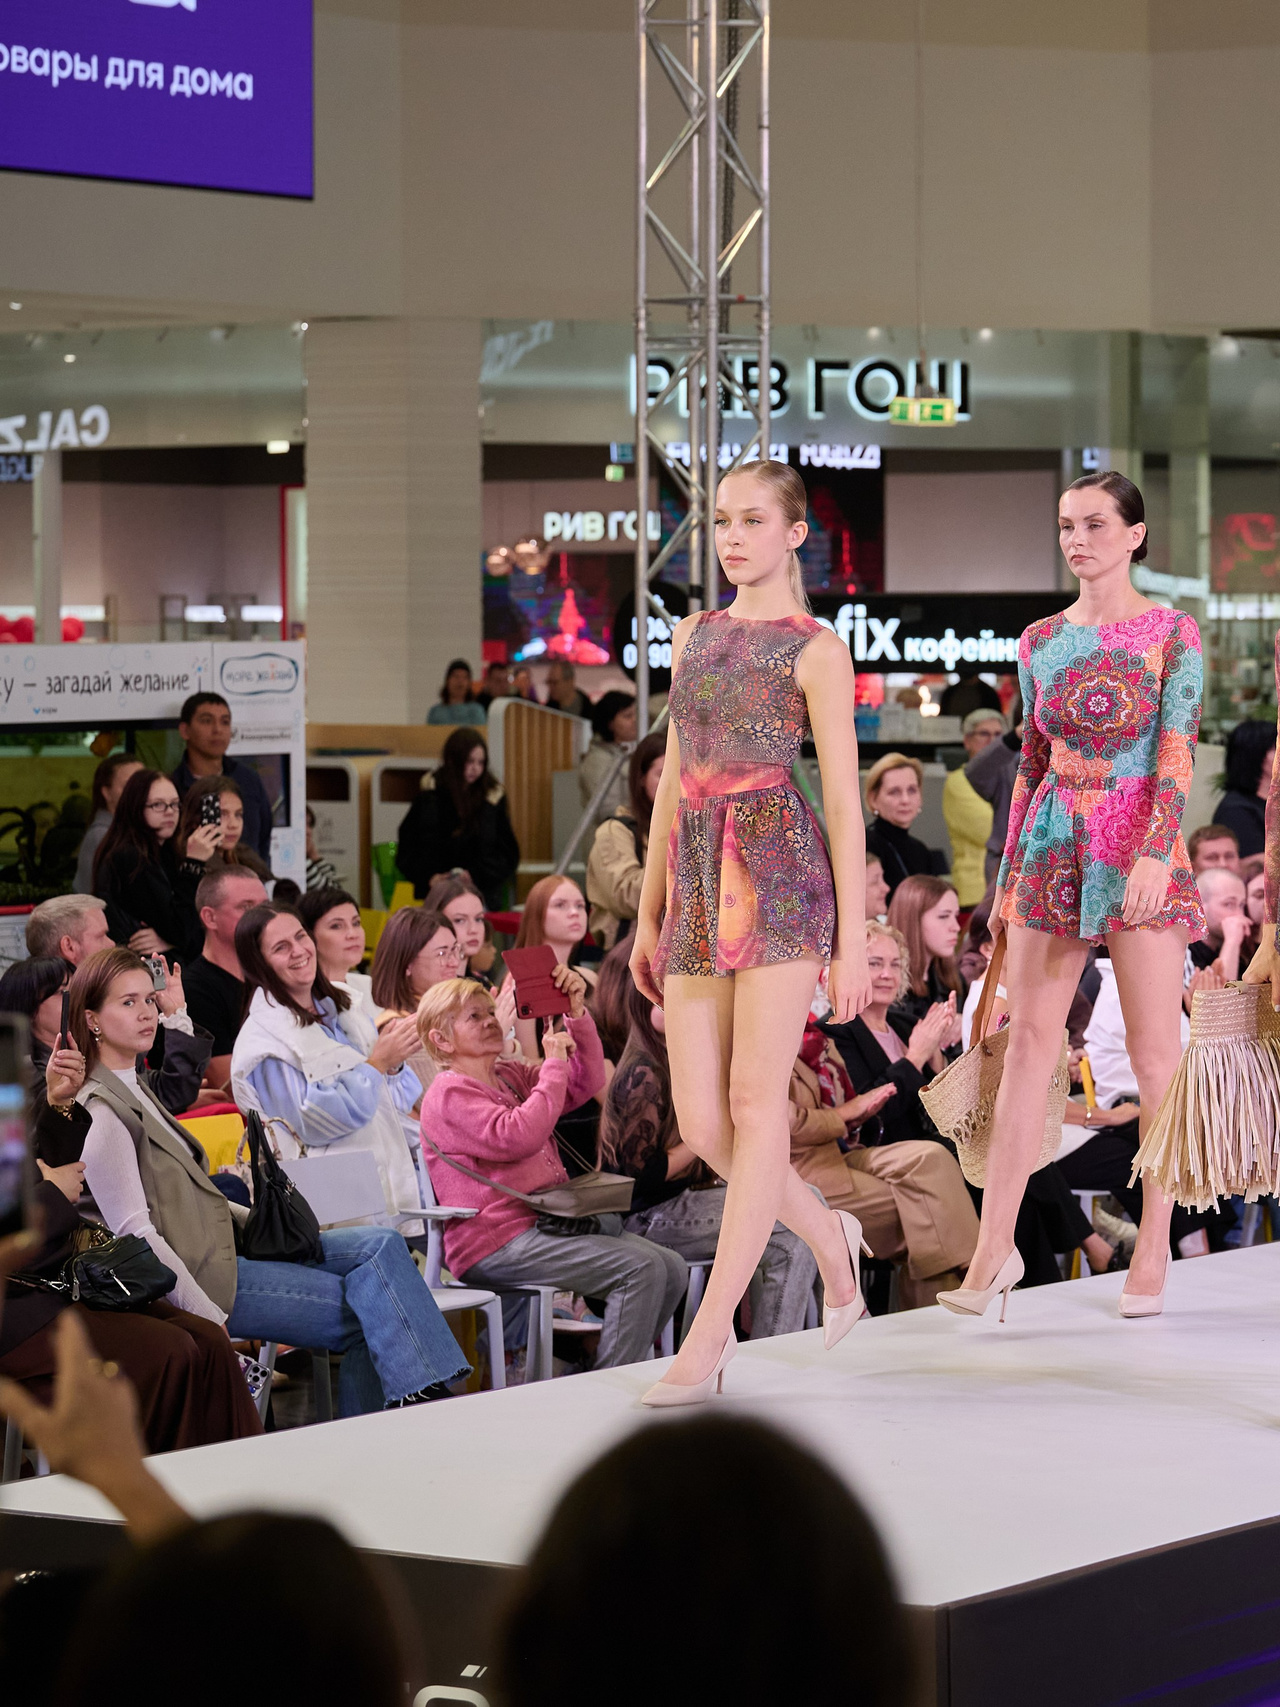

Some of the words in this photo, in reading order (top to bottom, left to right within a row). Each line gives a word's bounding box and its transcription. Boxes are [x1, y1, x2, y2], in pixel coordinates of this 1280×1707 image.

[104, 57, 164, 90] для
[170, 65, 254, 101] дома
[807, 357, 971, 422] ГОШ
[543, 511, 605, 541] РИВ
[815, 603, 901, 662] fix
[904, 628, 1020, 671] кофейн
[45, 671, 112, 694] загадай
[119, 673, 191, 695] желание
